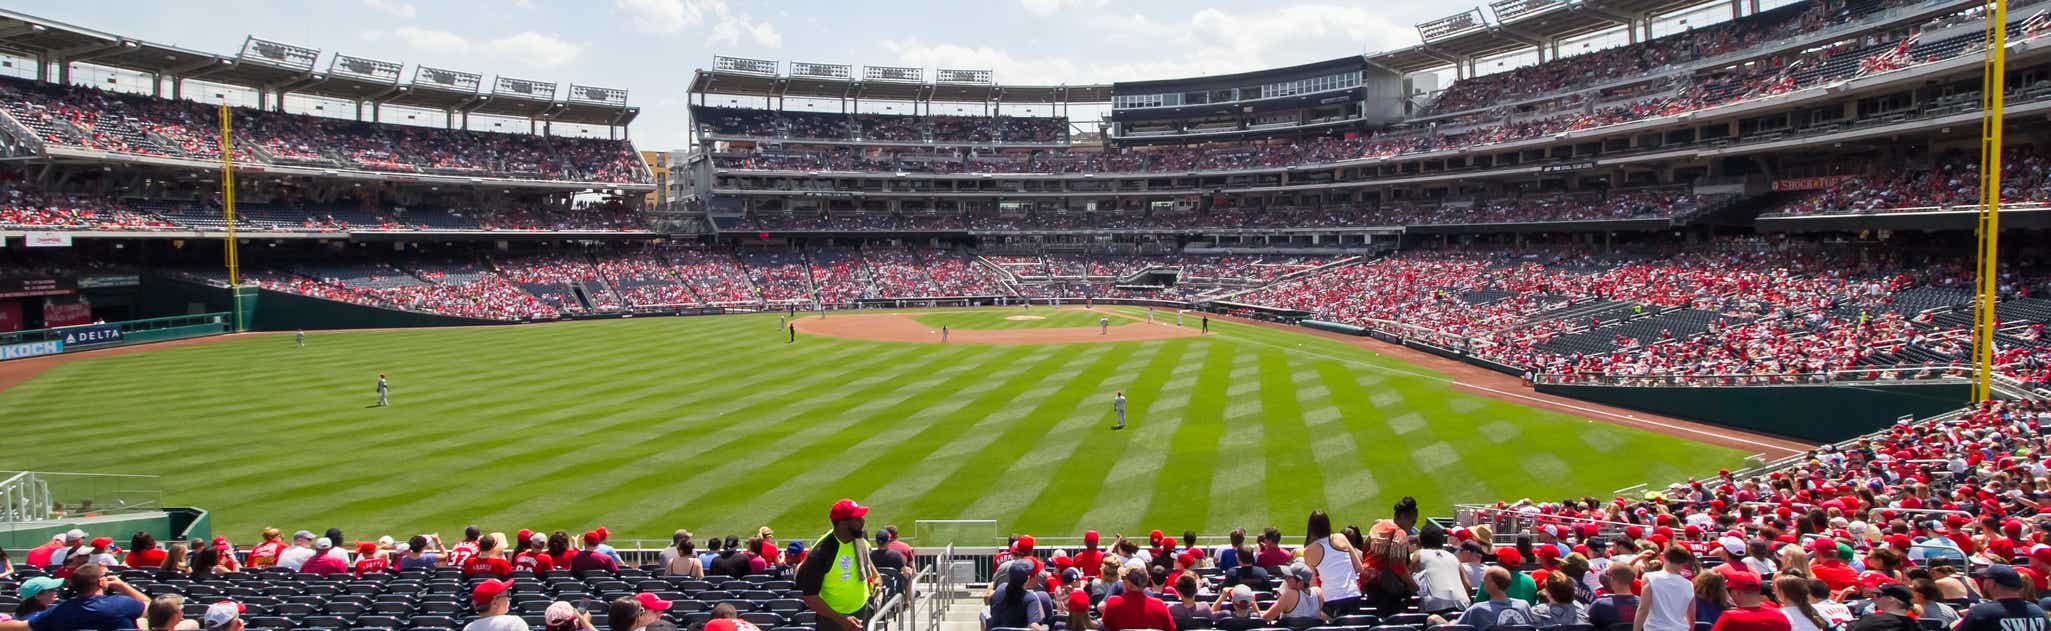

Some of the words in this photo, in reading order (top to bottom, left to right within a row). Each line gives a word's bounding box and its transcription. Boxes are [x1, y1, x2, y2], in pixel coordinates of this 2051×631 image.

[79, 329, 120, 342] DELTA
[448, 551, 472, 566] 37
[2000, 617, 2046, 631] SWAT
